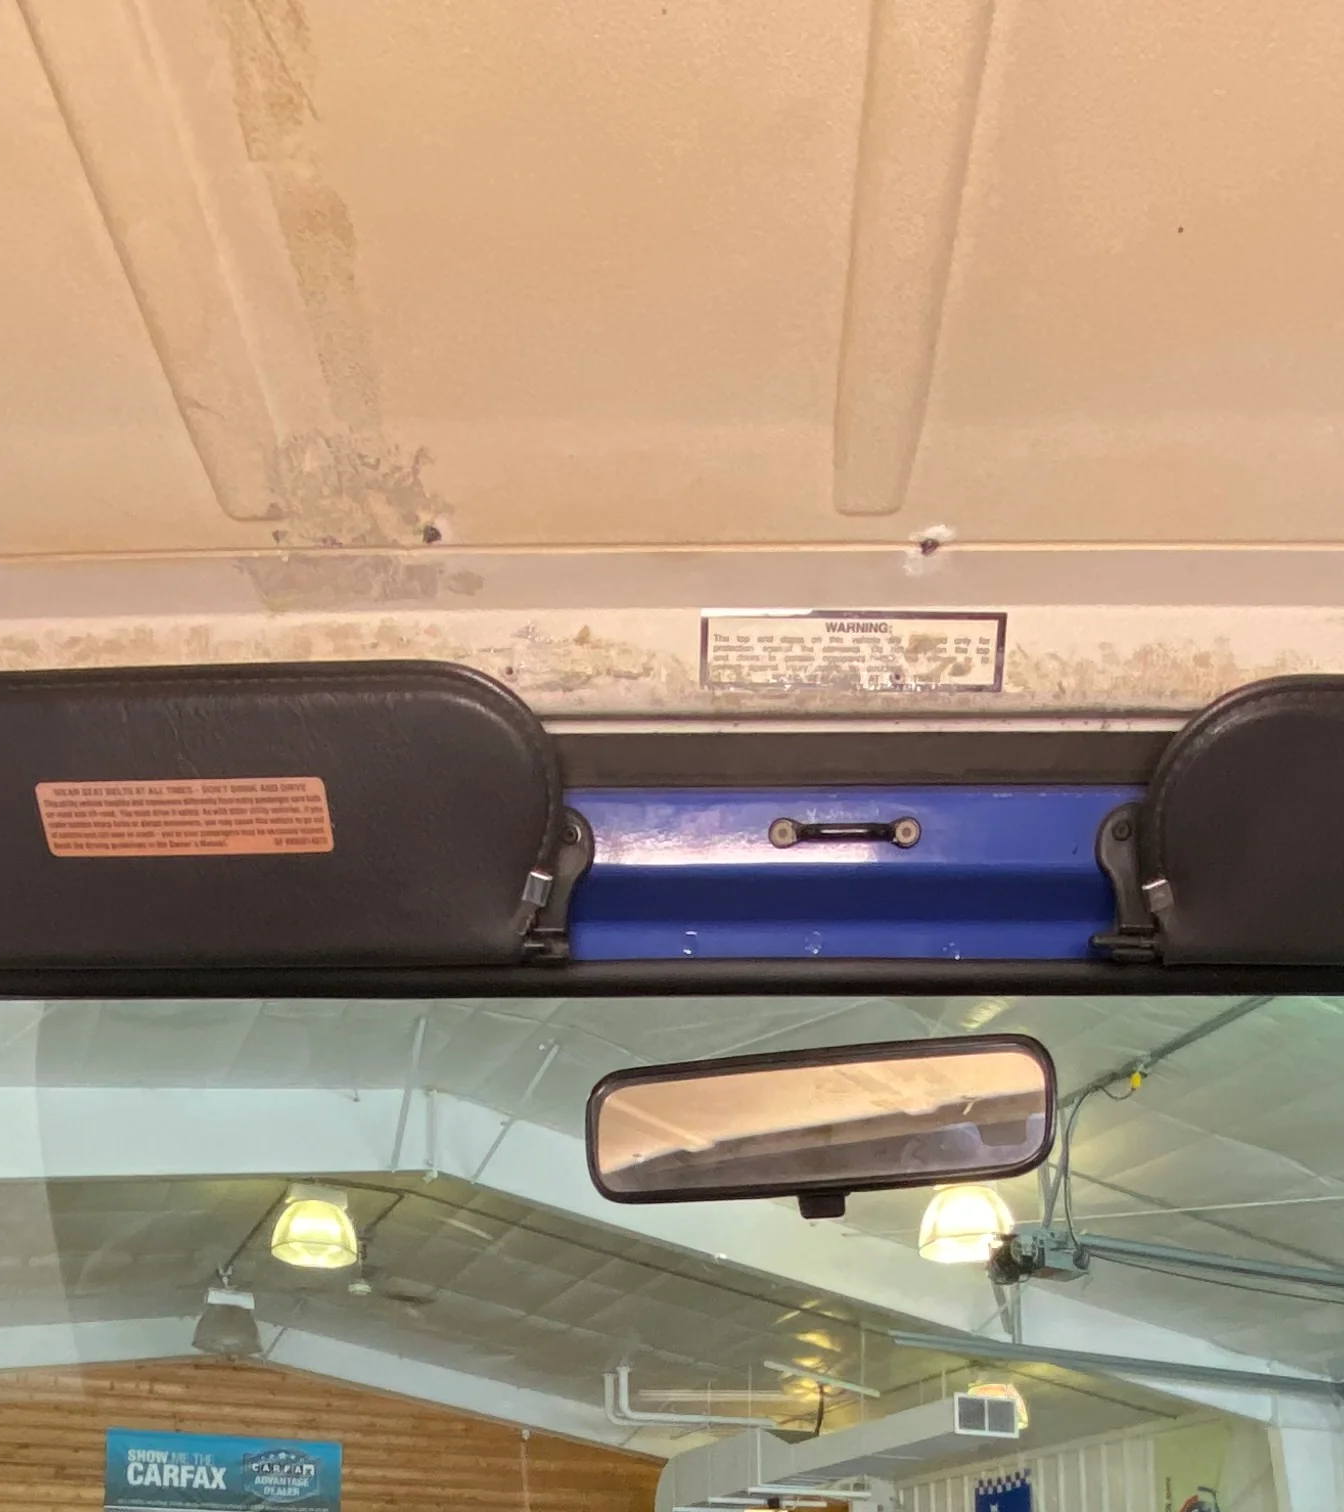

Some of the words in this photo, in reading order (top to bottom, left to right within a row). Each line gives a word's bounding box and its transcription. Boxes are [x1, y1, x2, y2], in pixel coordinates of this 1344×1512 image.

[824, 621, 893, 634] WARNING:
[127, 1449, 169, 1464] SHOW
[251, 1462, 315, 1476] CARFAX
[126, 1462, 227, 1490] CARFAX
[254, 1475, 310, 1488] ADVANTAGE
[263, 1486, 301, 1497] DEALER
